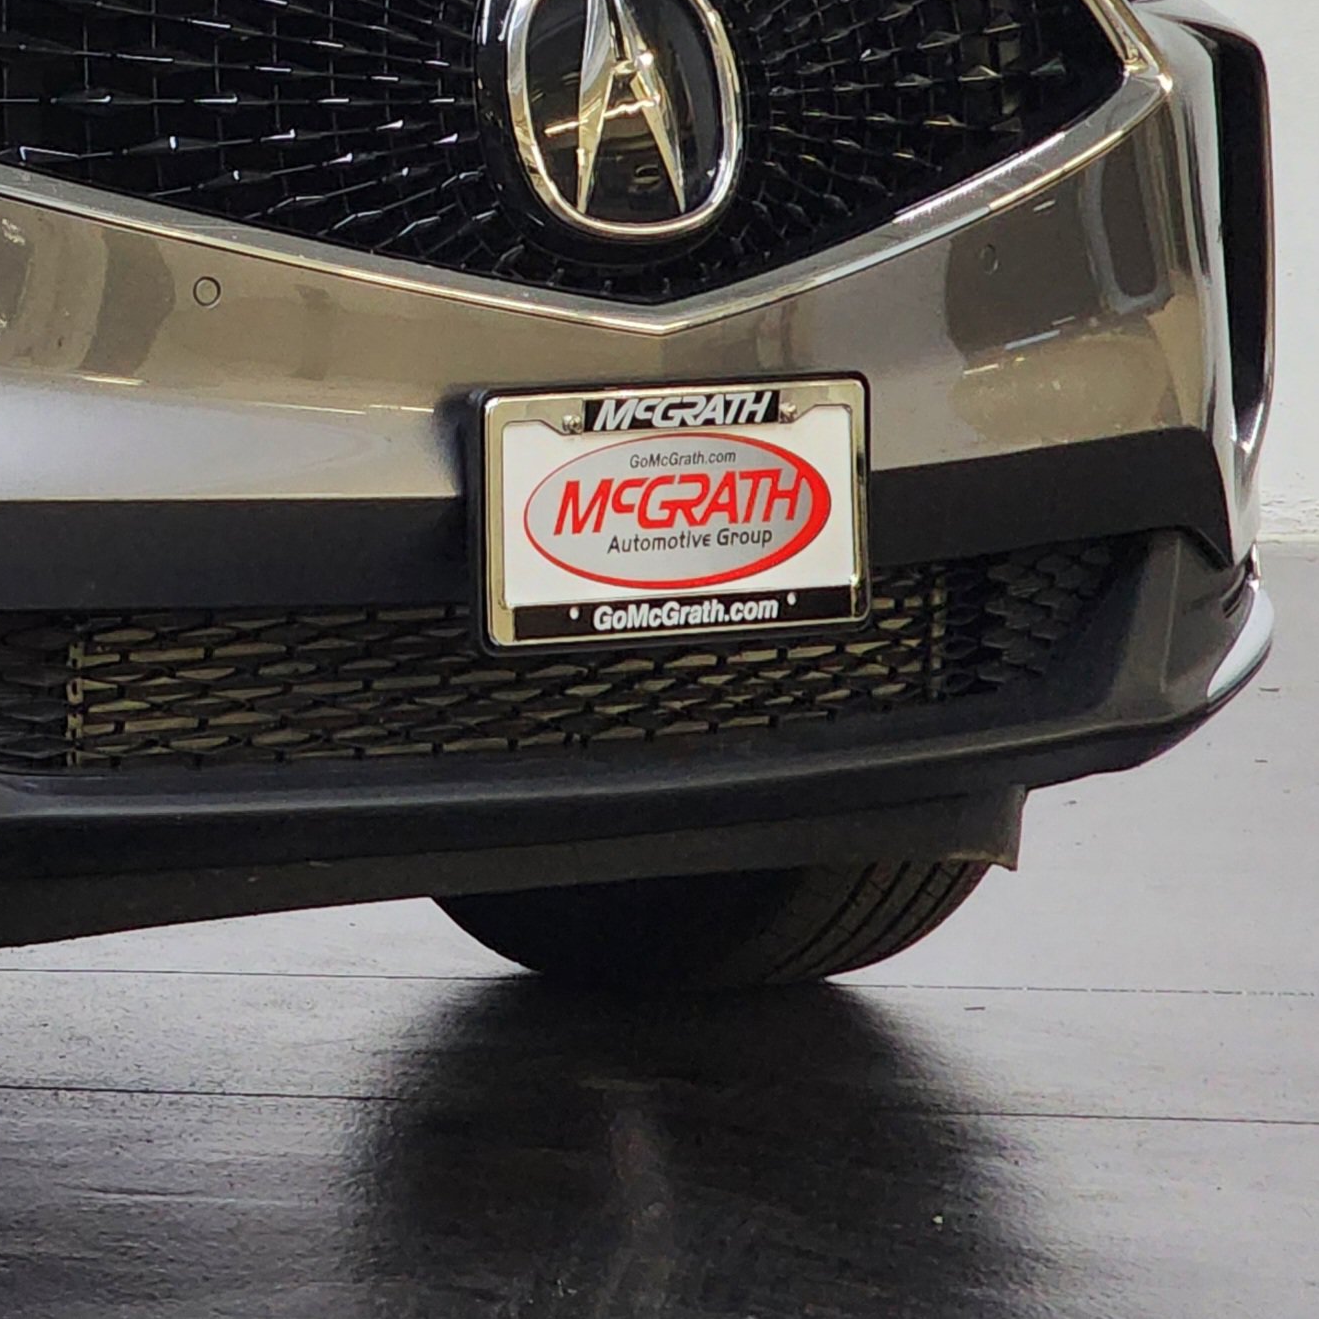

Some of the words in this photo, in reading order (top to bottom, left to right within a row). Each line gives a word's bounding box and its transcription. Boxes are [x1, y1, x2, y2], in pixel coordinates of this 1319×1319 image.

[629, 451, 737, 468] GoMcGrath.com
[607, 532, 712, 554] Automotive
[717, 527, 773, 549] Group
[593, 599, 778, 631] GoMcGrath.com
